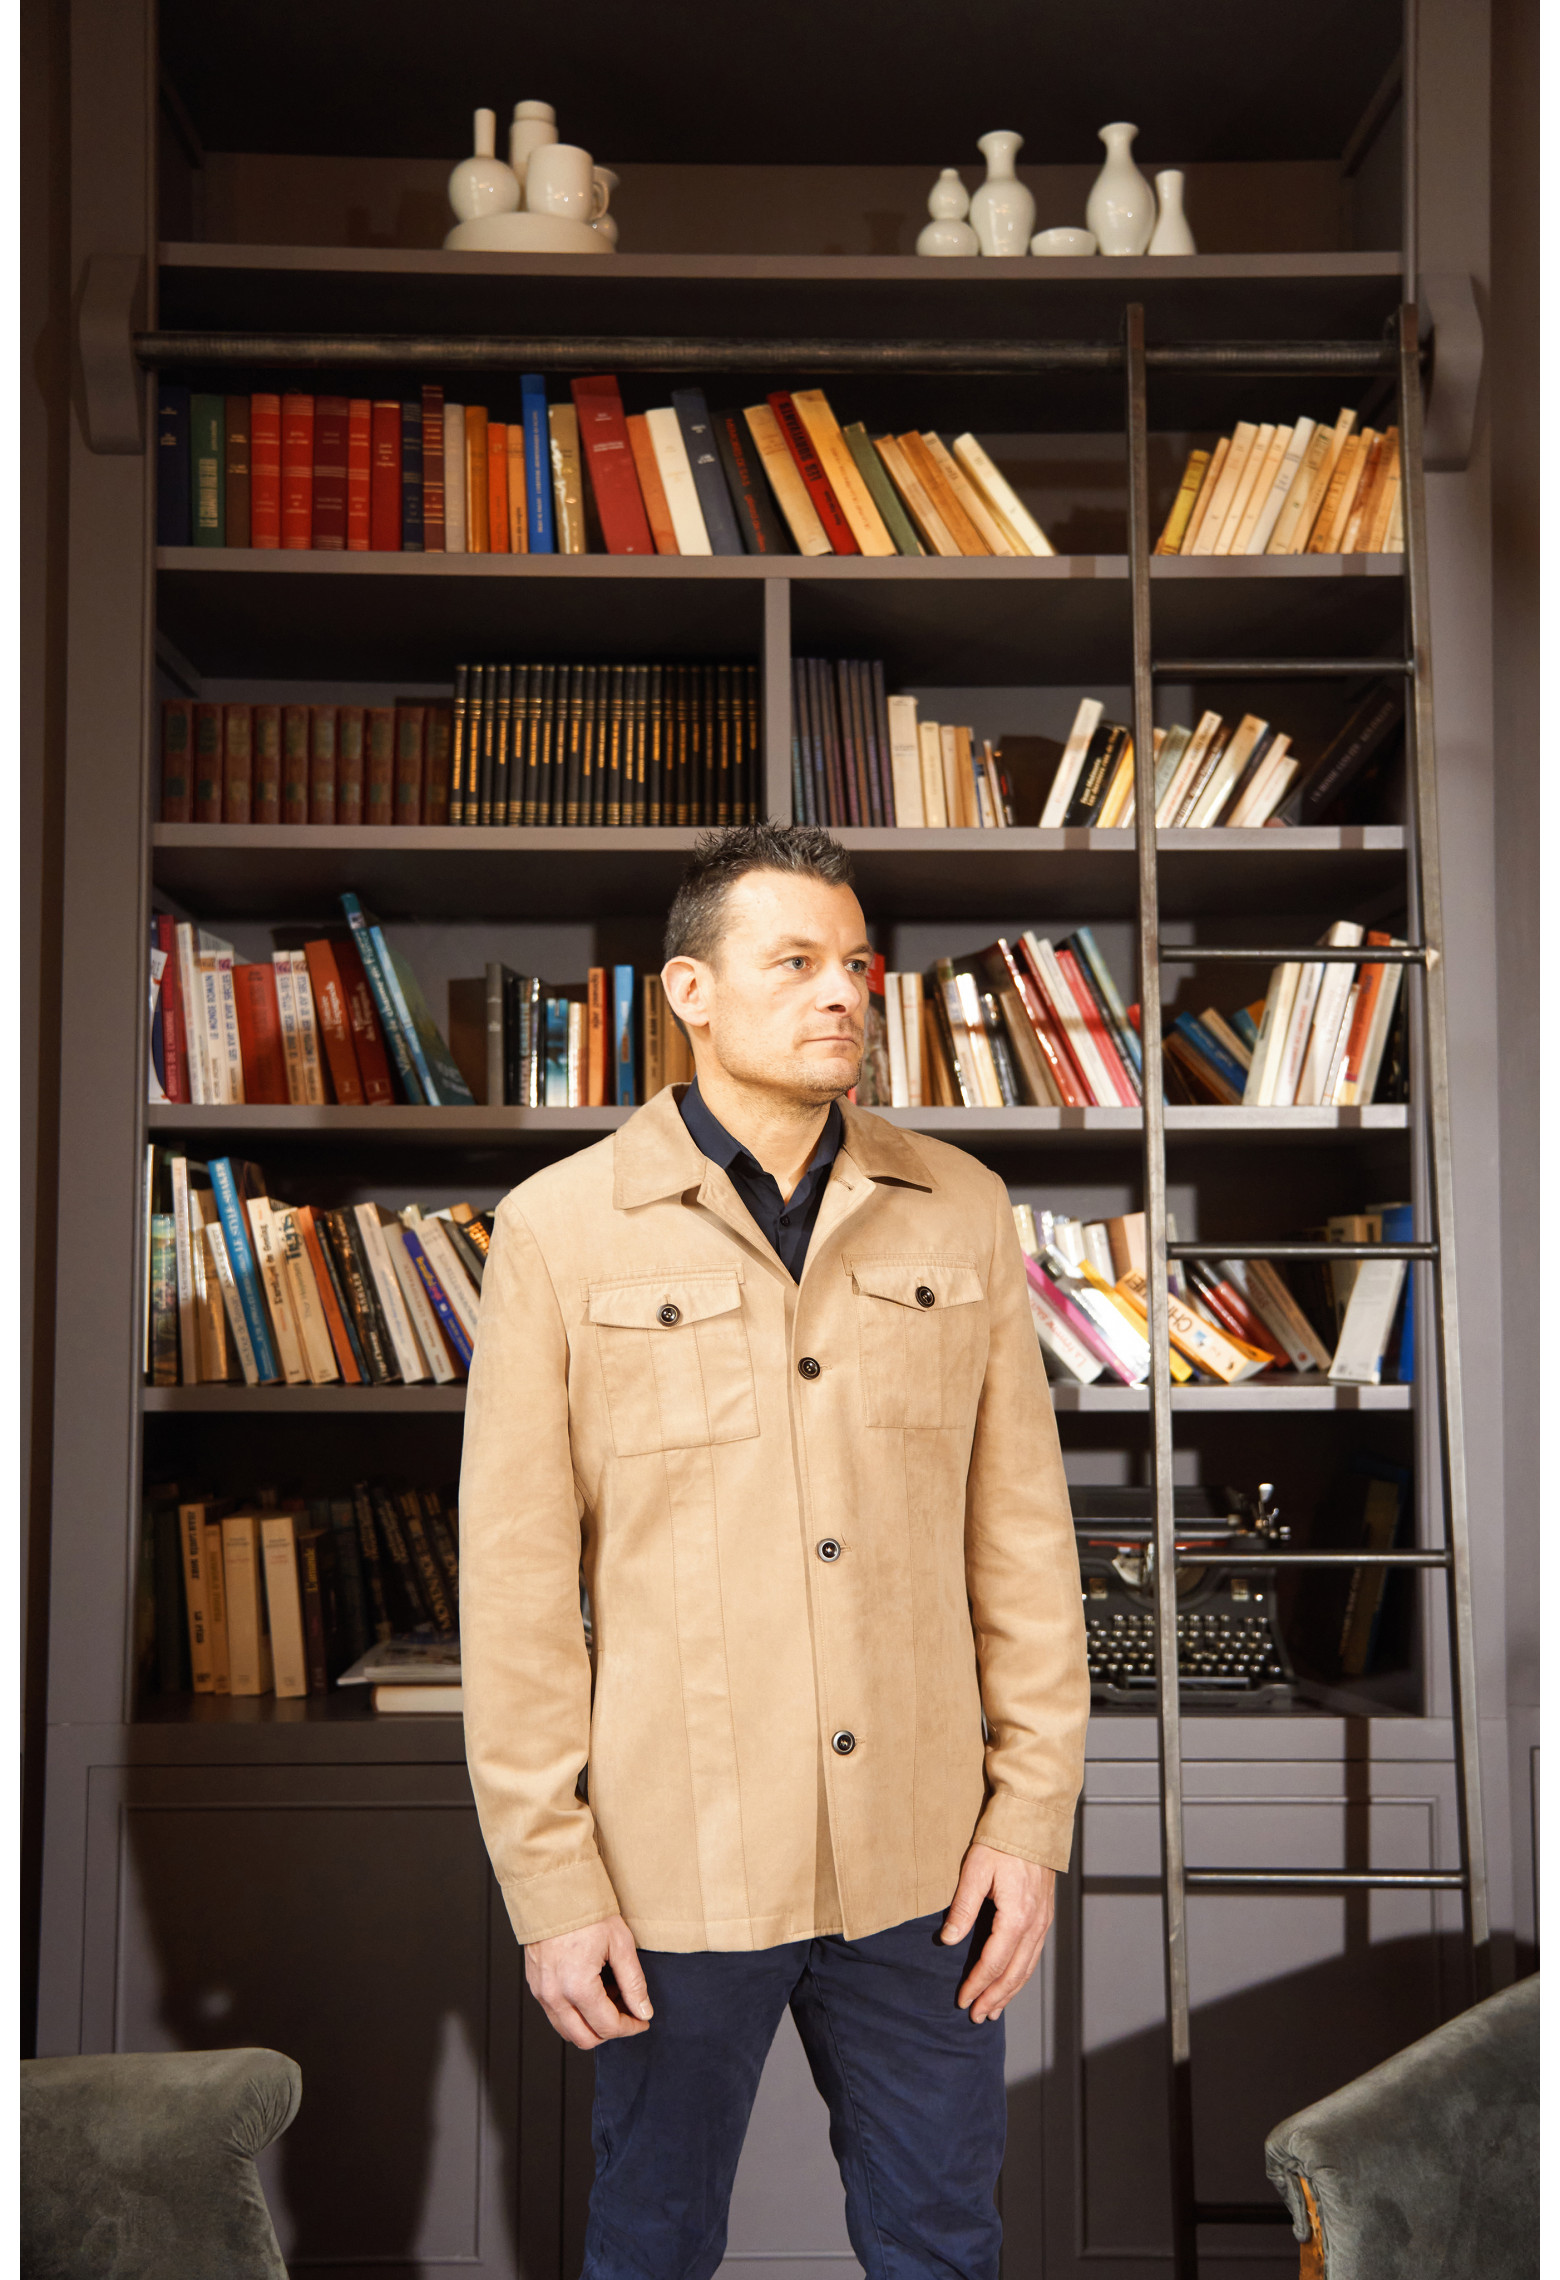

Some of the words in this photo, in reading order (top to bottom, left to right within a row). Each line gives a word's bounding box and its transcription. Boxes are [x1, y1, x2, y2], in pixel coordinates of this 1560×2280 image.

[205, 974, 216, 1003] ROMAIN
[373, 981, 394, 1019] charme
[207, 1005, 218, 1030] MONDE
[387, 1019, 399, 1033] de
[166, 1051, 176, 1063] DE
[389, 1032, 413, 1076] Villages
[167, 1063, 179, 1096] DROITS
[276, 1210, 308, 1264] Tigris
